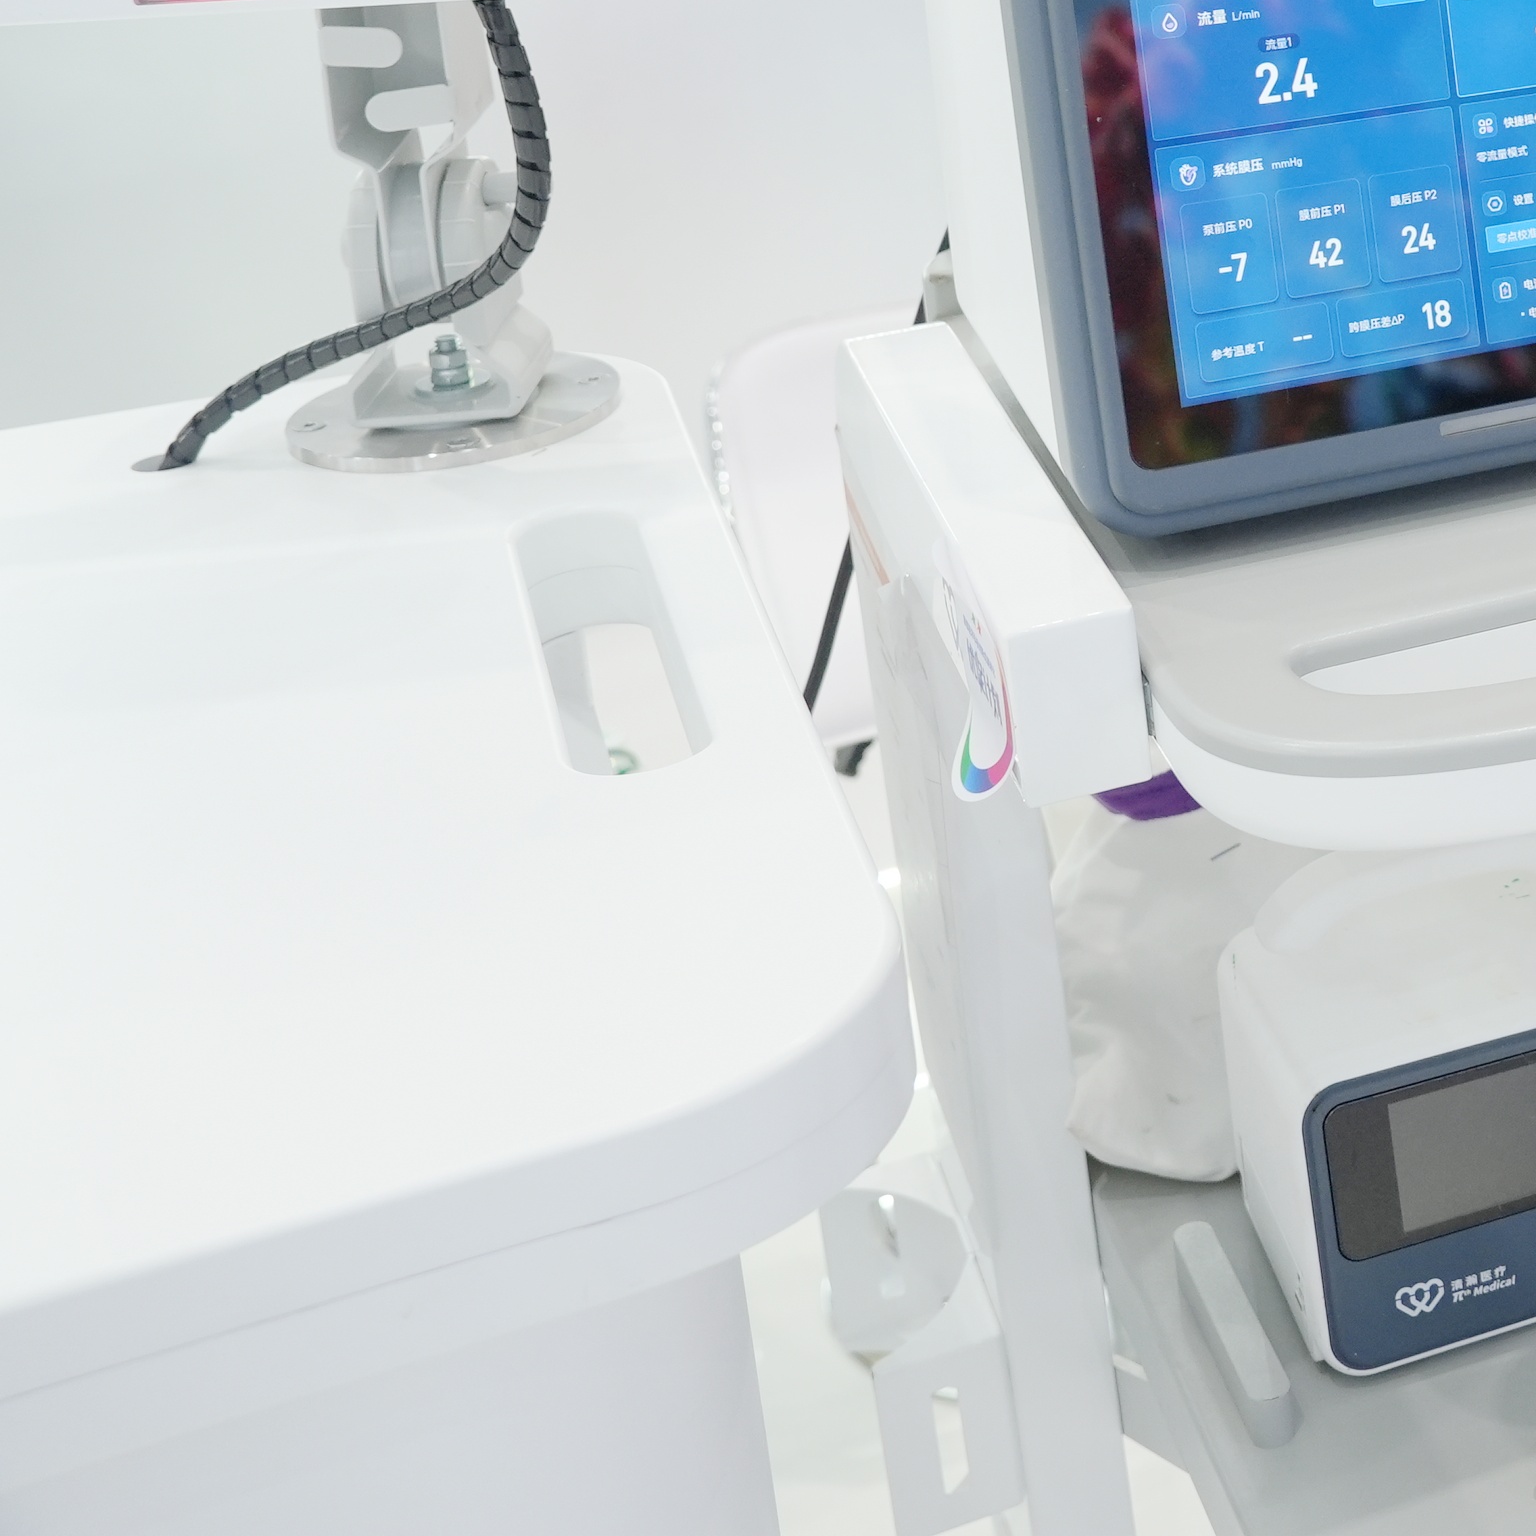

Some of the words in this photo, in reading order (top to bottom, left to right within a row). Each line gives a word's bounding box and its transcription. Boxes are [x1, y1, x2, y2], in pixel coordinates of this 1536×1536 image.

[1197, 9, 1227, 27] 流量
[1232, 10, 1260, 22] L/min
[1265, 37, 1292, 51] 流量1
[1255, 57, 1318, 105] 2.4
[1476, 145, 1528, 163] 零流量模式
[1213, 158, 1264, 178] 系统膜压
[1271, 157, 1303, 170] mmHg
[1390, 191, 1422, 207] 膜后压
[1424, 189, 1437, 201] P2
[1513, 193, 1534, 206] 设置
[1299, 205, 1332, 221] 膜前压
[1334, 204, 1345, 215] P1
[1203, 221, 1236, 236] 泵前压
[1401, 223, 1436, 254] 24
[1309, 237, 1344, 269] 42
[1219, 252, 1248, 282] -7
[1421, 300, 1452, 330] 18
[1211, 342, 1256, 361] 参考温度
[1258, 341, 1265, 351] T
[1474, 1275, 1516, 1299] Medical
